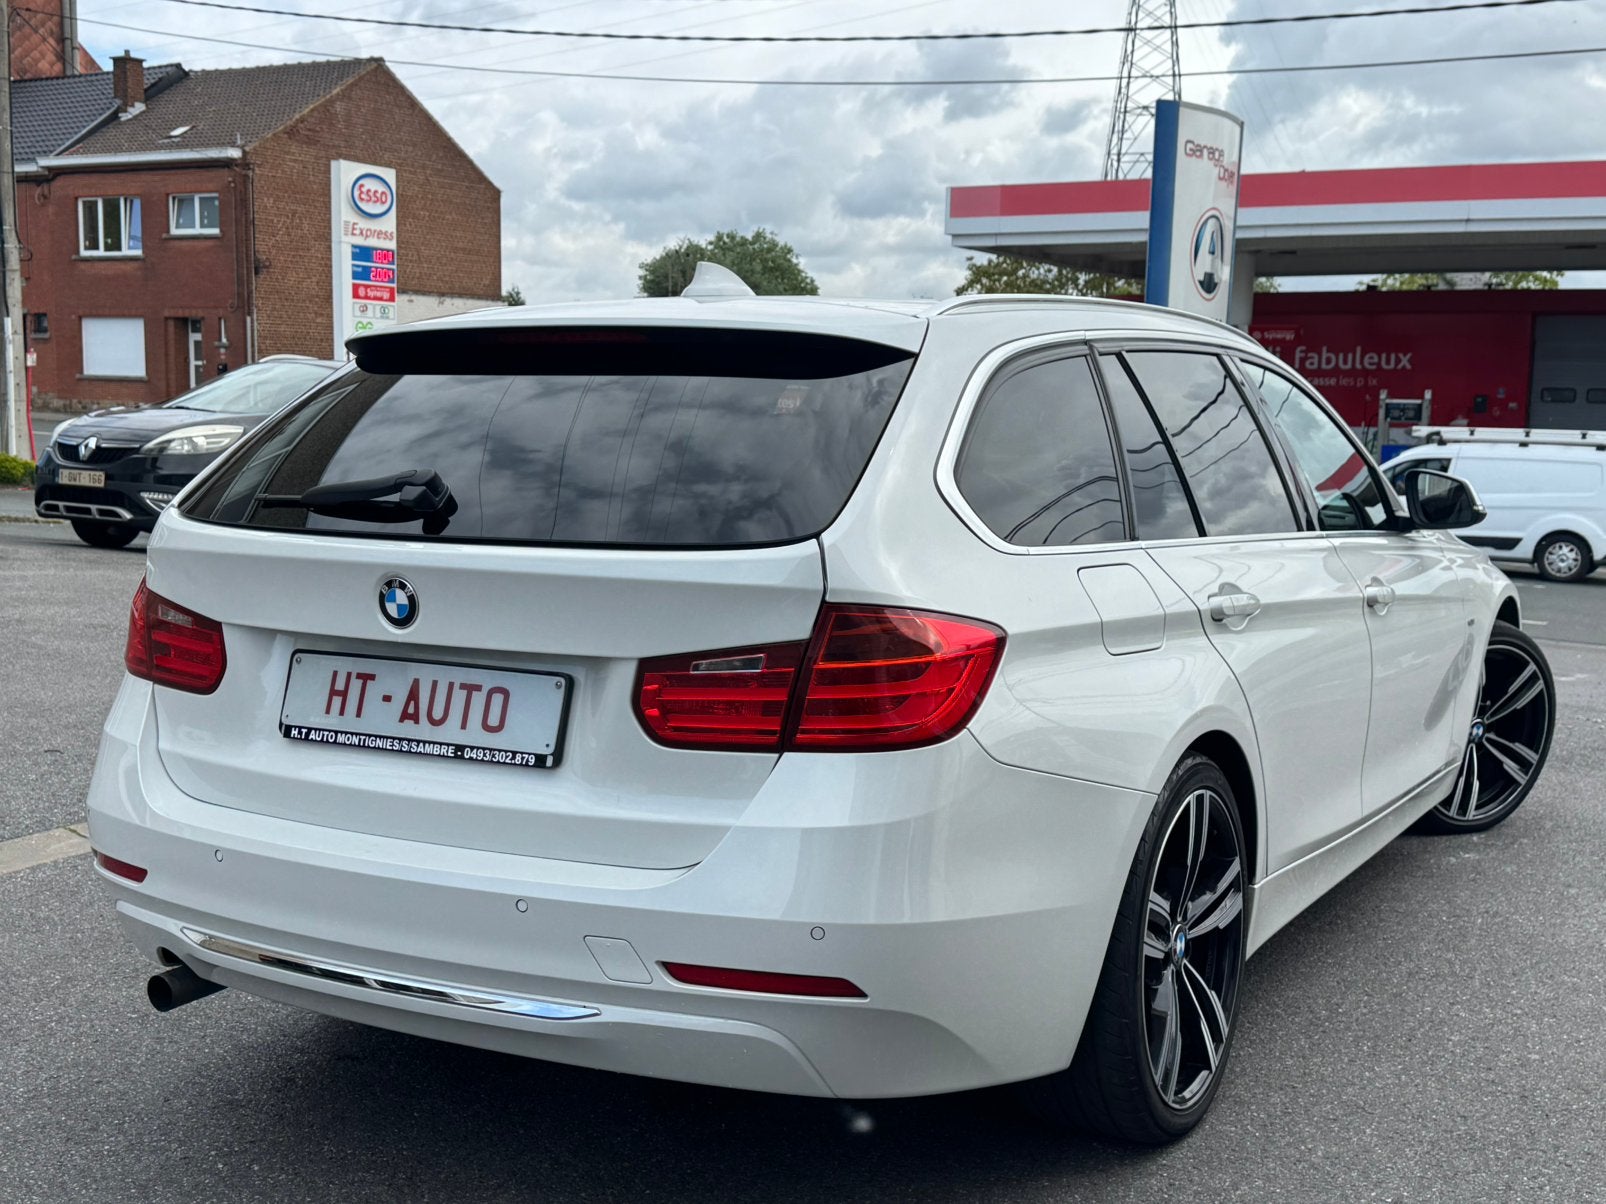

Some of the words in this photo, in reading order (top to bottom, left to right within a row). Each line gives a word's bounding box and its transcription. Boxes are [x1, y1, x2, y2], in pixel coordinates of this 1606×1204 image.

[1184, 139, 1225, 166] Garage
[351, 222, 394, 241] Express
[1294, 345, 1412, 369] fabuleux
[1338, 374, 1354, 387] les
[290, 727, 307, 739] H.T
[308, 729, 336, 743] AUTO
[336, 732, 455, 757] MONTIGNIES/S/SAMBRE
[464, 748, 536, 766] 0493/302.879
